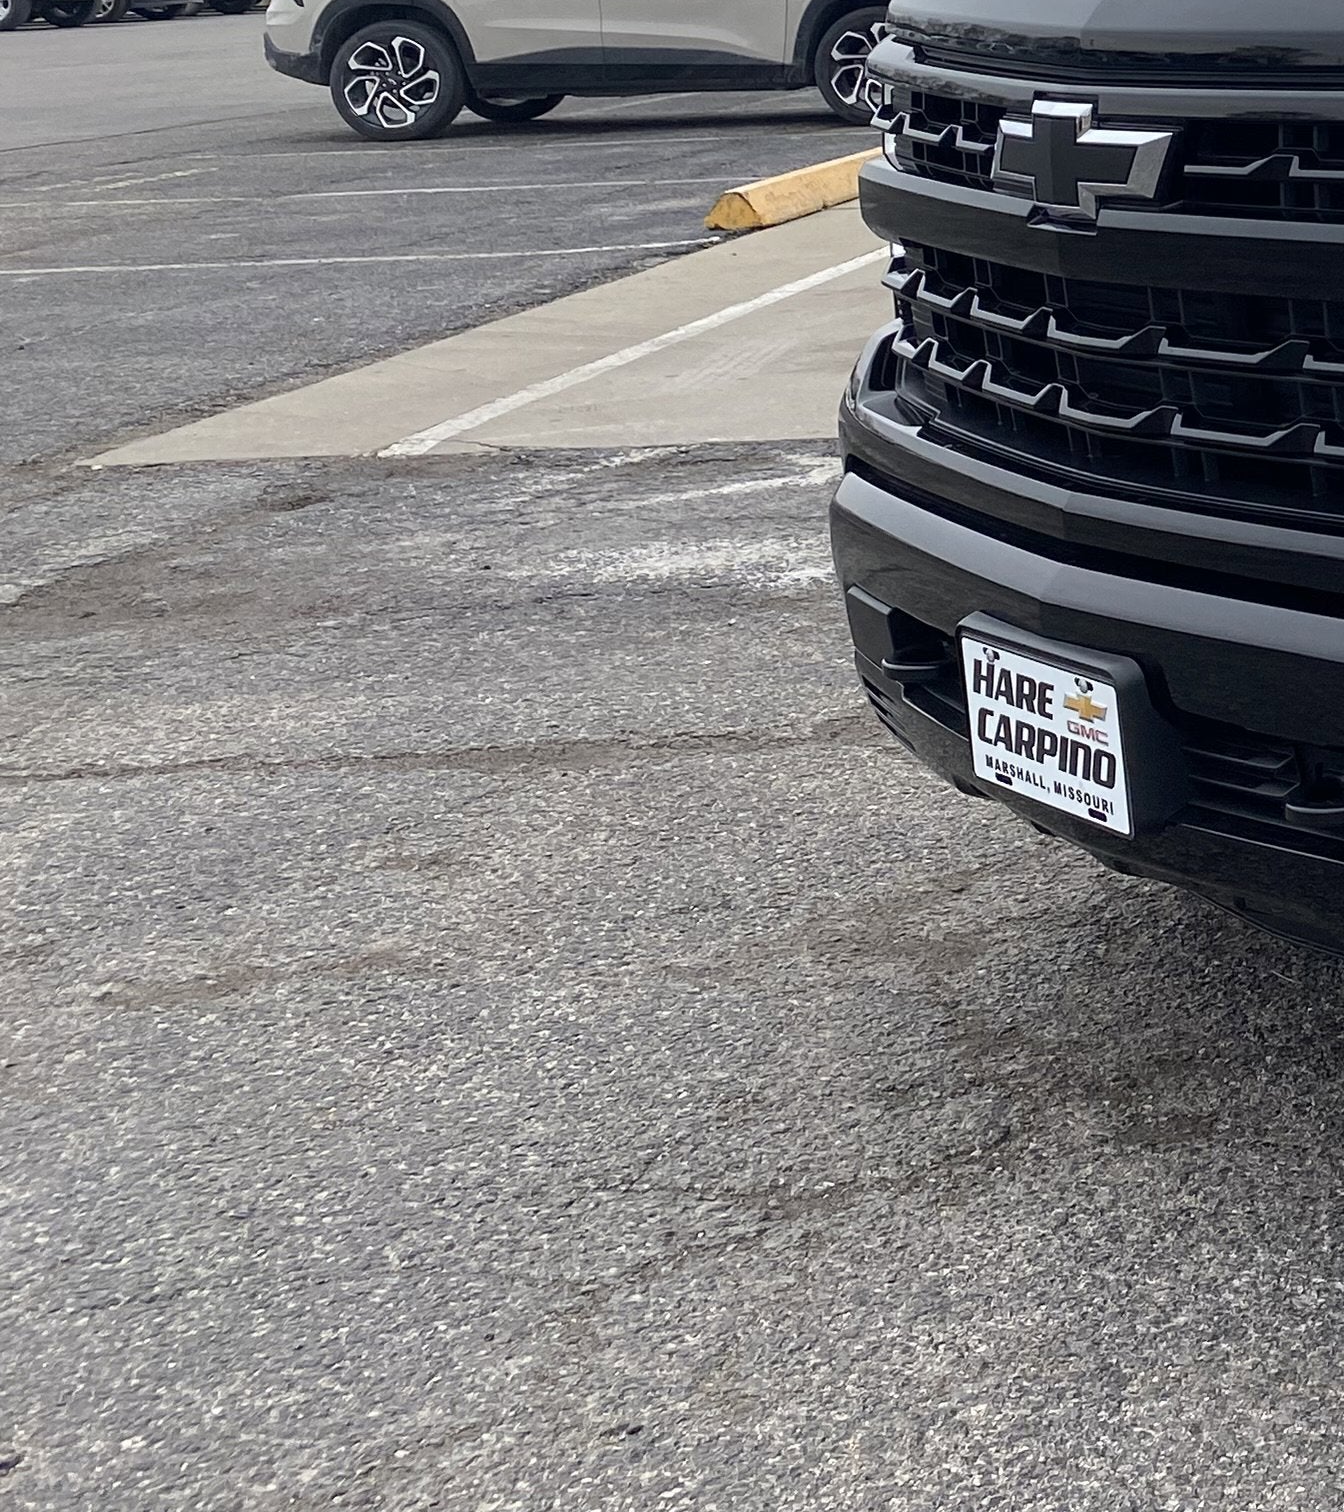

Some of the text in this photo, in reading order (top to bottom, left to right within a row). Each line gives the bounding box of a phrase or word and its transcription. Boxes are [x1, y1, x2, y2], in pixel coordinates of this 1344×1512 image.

[973, 658, 1055, 720] HARE
[977, 707, 1117, 790] CARPINO
[1066, 720, 1109, 746] GMC
[985, 754, 1114, 815] MARSHALL, MISSOURI
